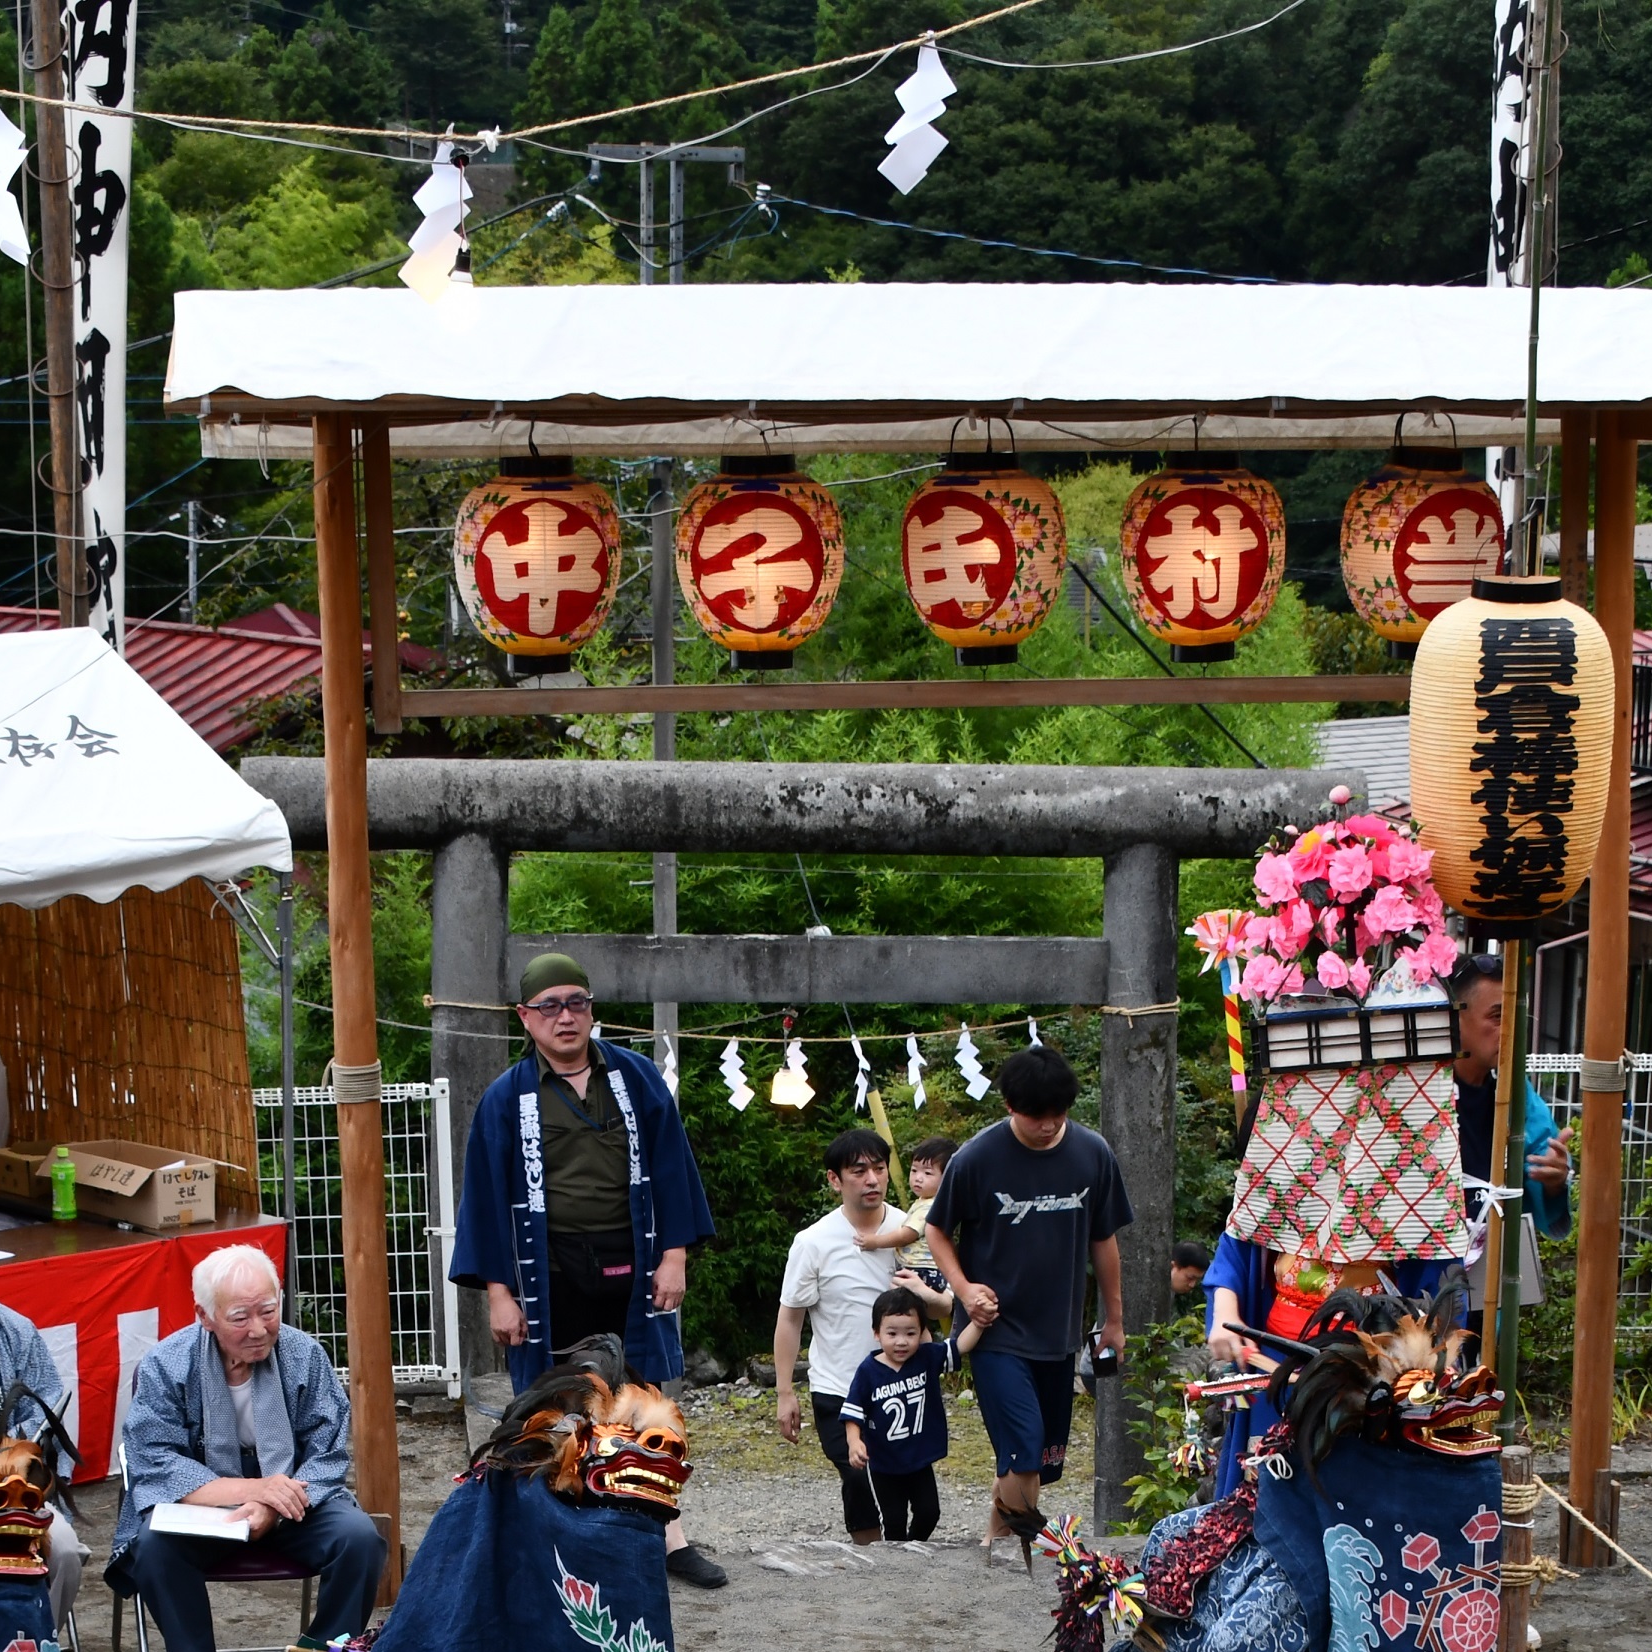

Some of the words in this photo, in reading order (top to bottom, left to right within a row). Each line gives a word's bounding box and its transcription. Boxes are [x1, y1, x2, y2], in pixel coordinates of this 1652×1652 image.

[482, 501, 603, 636] 中
[699, 507, 813, 630] 子
[906, 505, 1001, 619] 氏
[1144, 504, 1258, 620] 村
[871, 1380, 907, 1401] LAGUNA
[882, 1388, 925, 1441] 27
